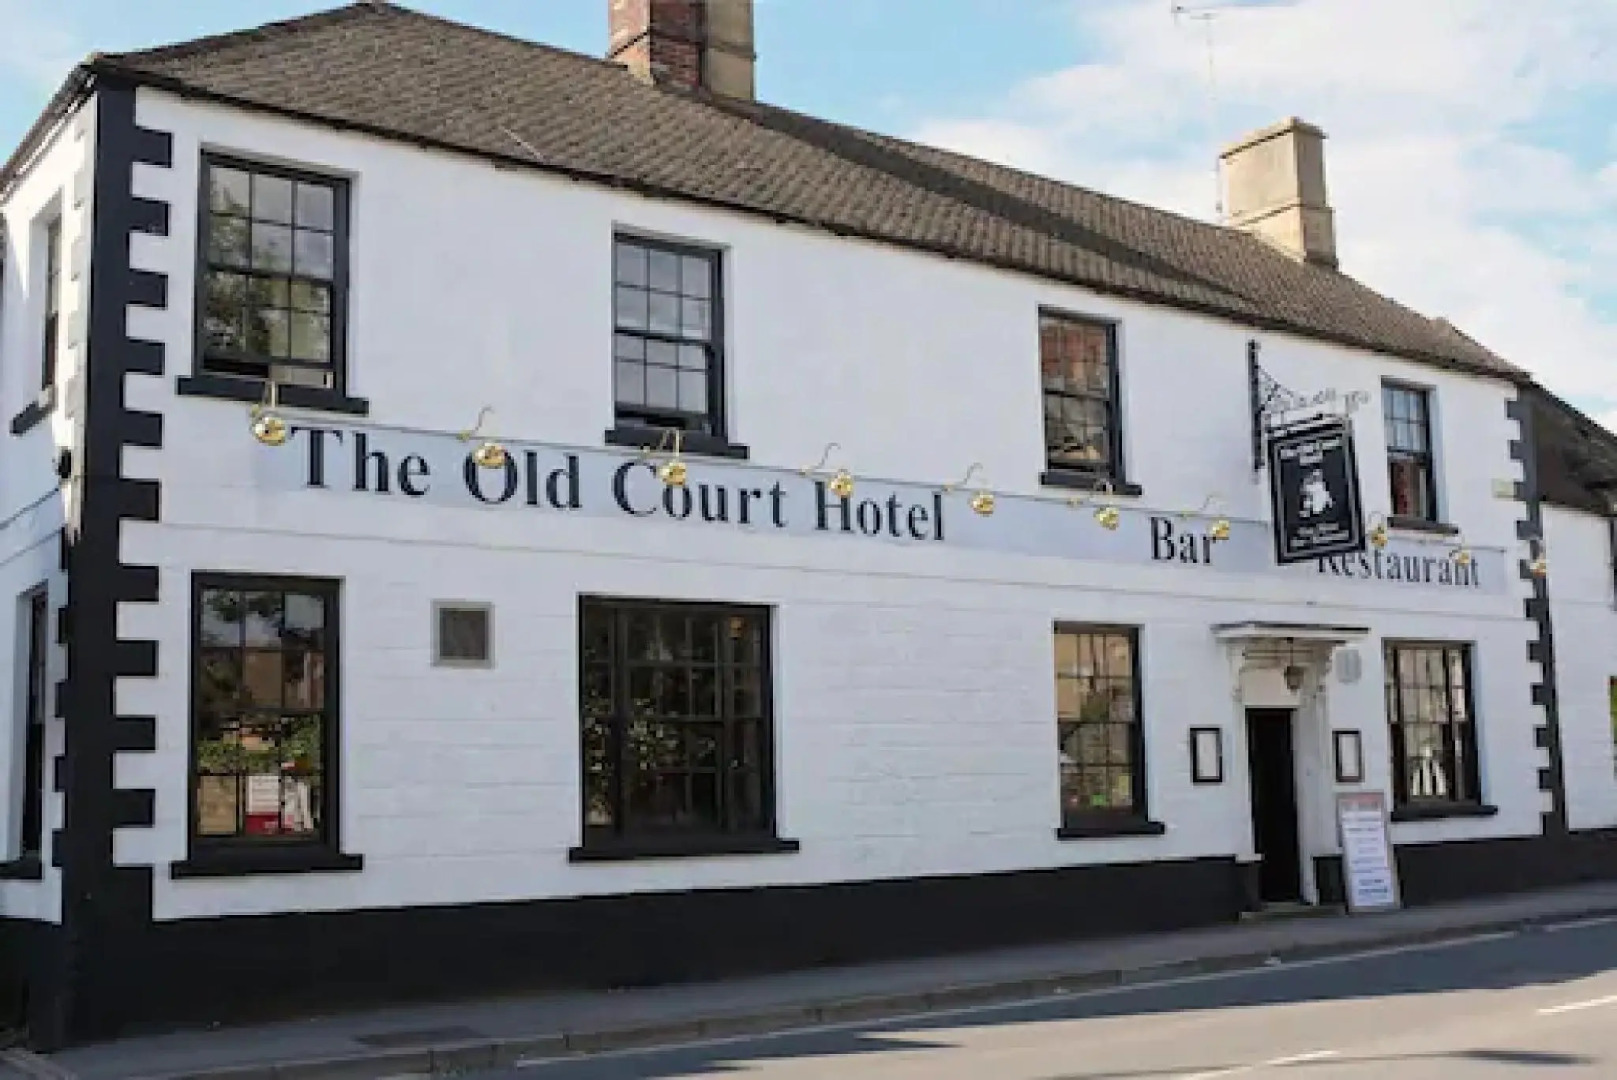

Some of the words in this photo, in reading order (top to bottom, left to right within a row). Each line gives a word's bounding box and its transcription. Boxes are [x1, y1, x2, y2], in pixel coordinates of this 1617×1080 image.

[290, 426, 430, 497] The
[463, 443, 582, 509] Old
[611, 460, 788, 528] Court
[815, 479, 945, 541] Hotel
[1150, 516, 1218, 565] Bar
